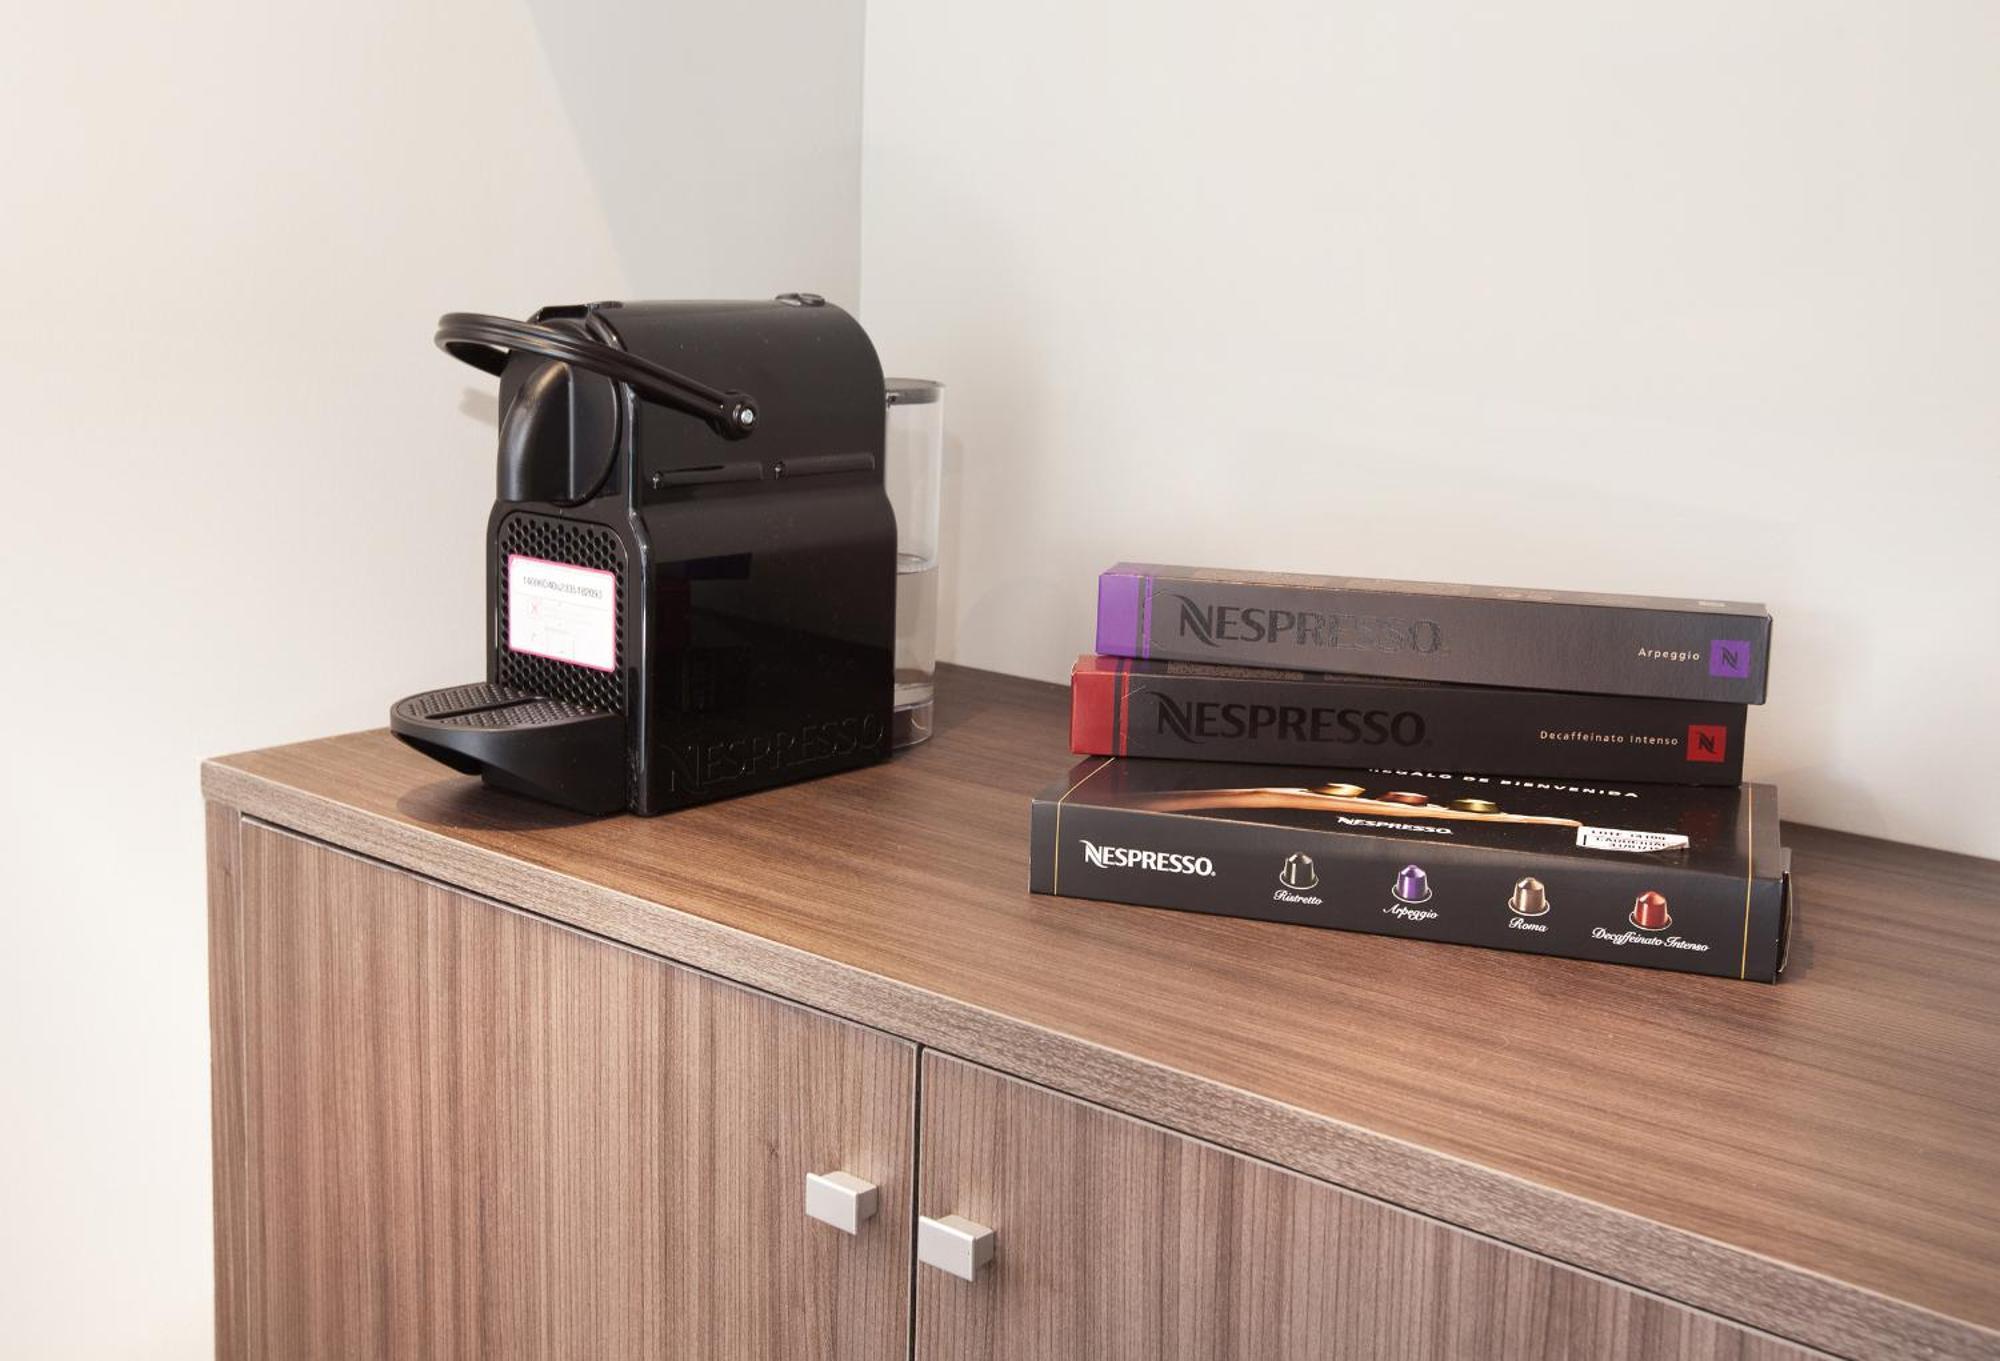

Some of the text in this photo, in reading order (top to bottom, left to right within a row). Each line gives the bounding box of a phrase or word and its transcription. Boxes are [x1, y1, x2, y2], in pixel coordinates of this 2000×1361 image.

[1160, 592, 1443, 654] NESPRESSO
[1638, 647, 1701, 662] Arpeggio
[1146, 690, 1428, 748] NESPRESSO
[1540, 730, 1679, 746] Decaffeinato Intenso
[661, 714, 884, 795] NESPRESSO
[1463, 776, 1489, 784] DE
[1500, 780, 1638, 798] BIENVENIDA
[1336, 816, 1454, 835] NESPRESSO
[1079, 839, 1217, 877] NESPRESSO
[1273, 888, 1322, 906] Ristretto
[1383, 903, 1439, 921] Arpeggio
[1508, 917, 1549, 933] Roma
[1591, 927, 1710, 953] Decaffeinato Intenso
